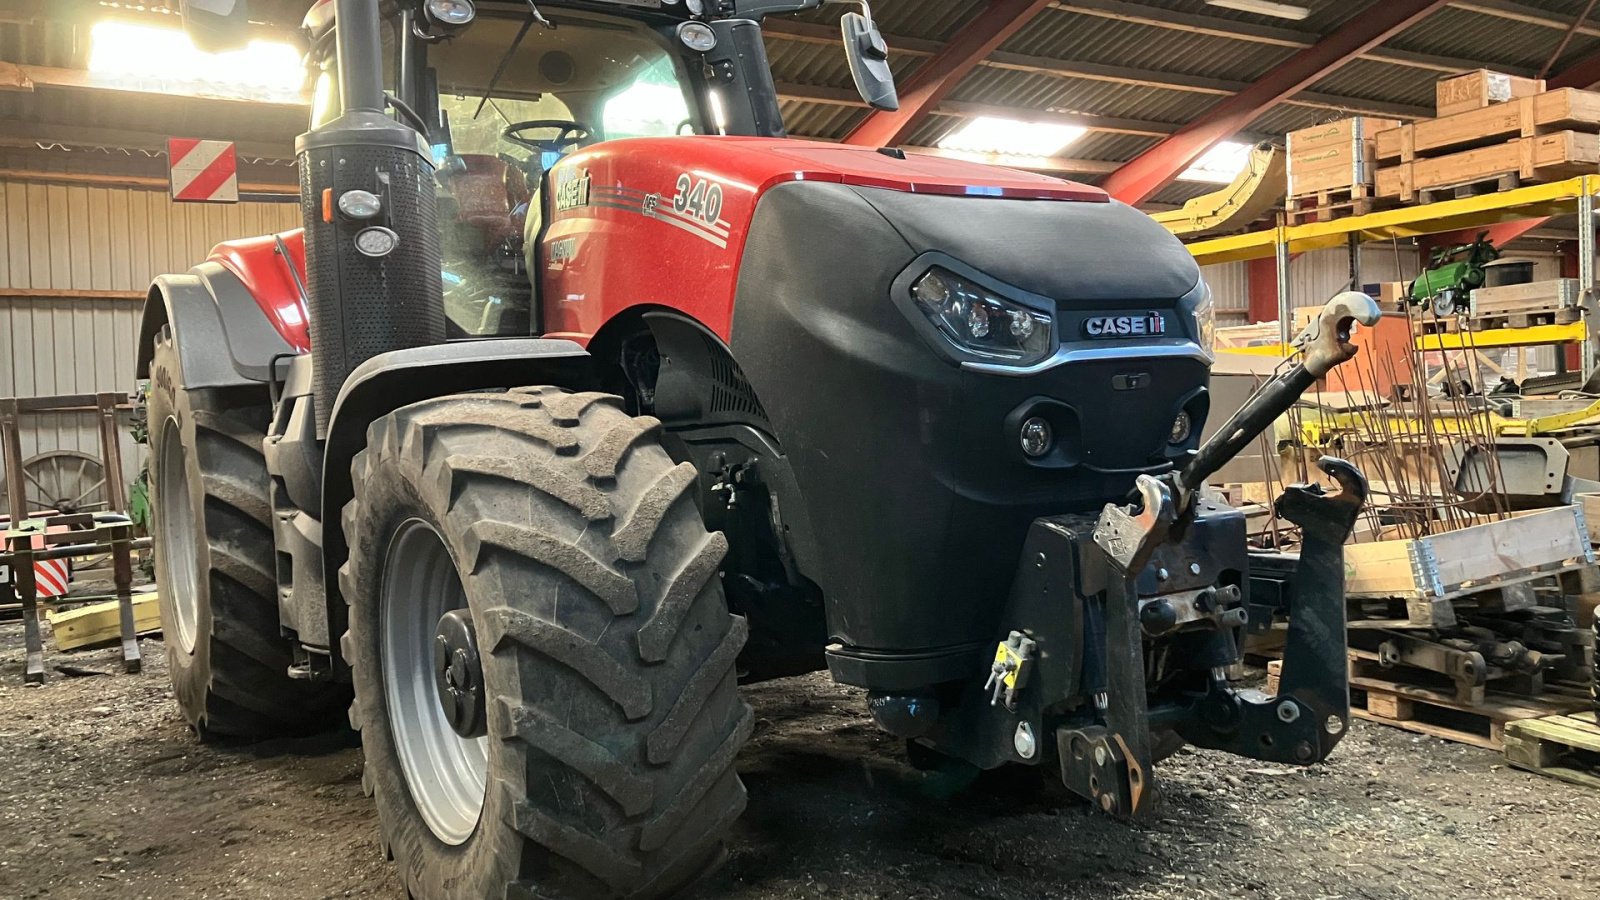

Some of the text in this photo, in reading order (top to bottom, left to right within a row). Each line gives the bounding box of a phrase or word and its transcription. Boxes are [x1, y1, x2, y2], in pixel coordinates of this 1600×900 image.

[556, 179, 579, 210] CASE
[673, 173, 722, 226] 340
[1086, 316, 1146, 336] CASE
